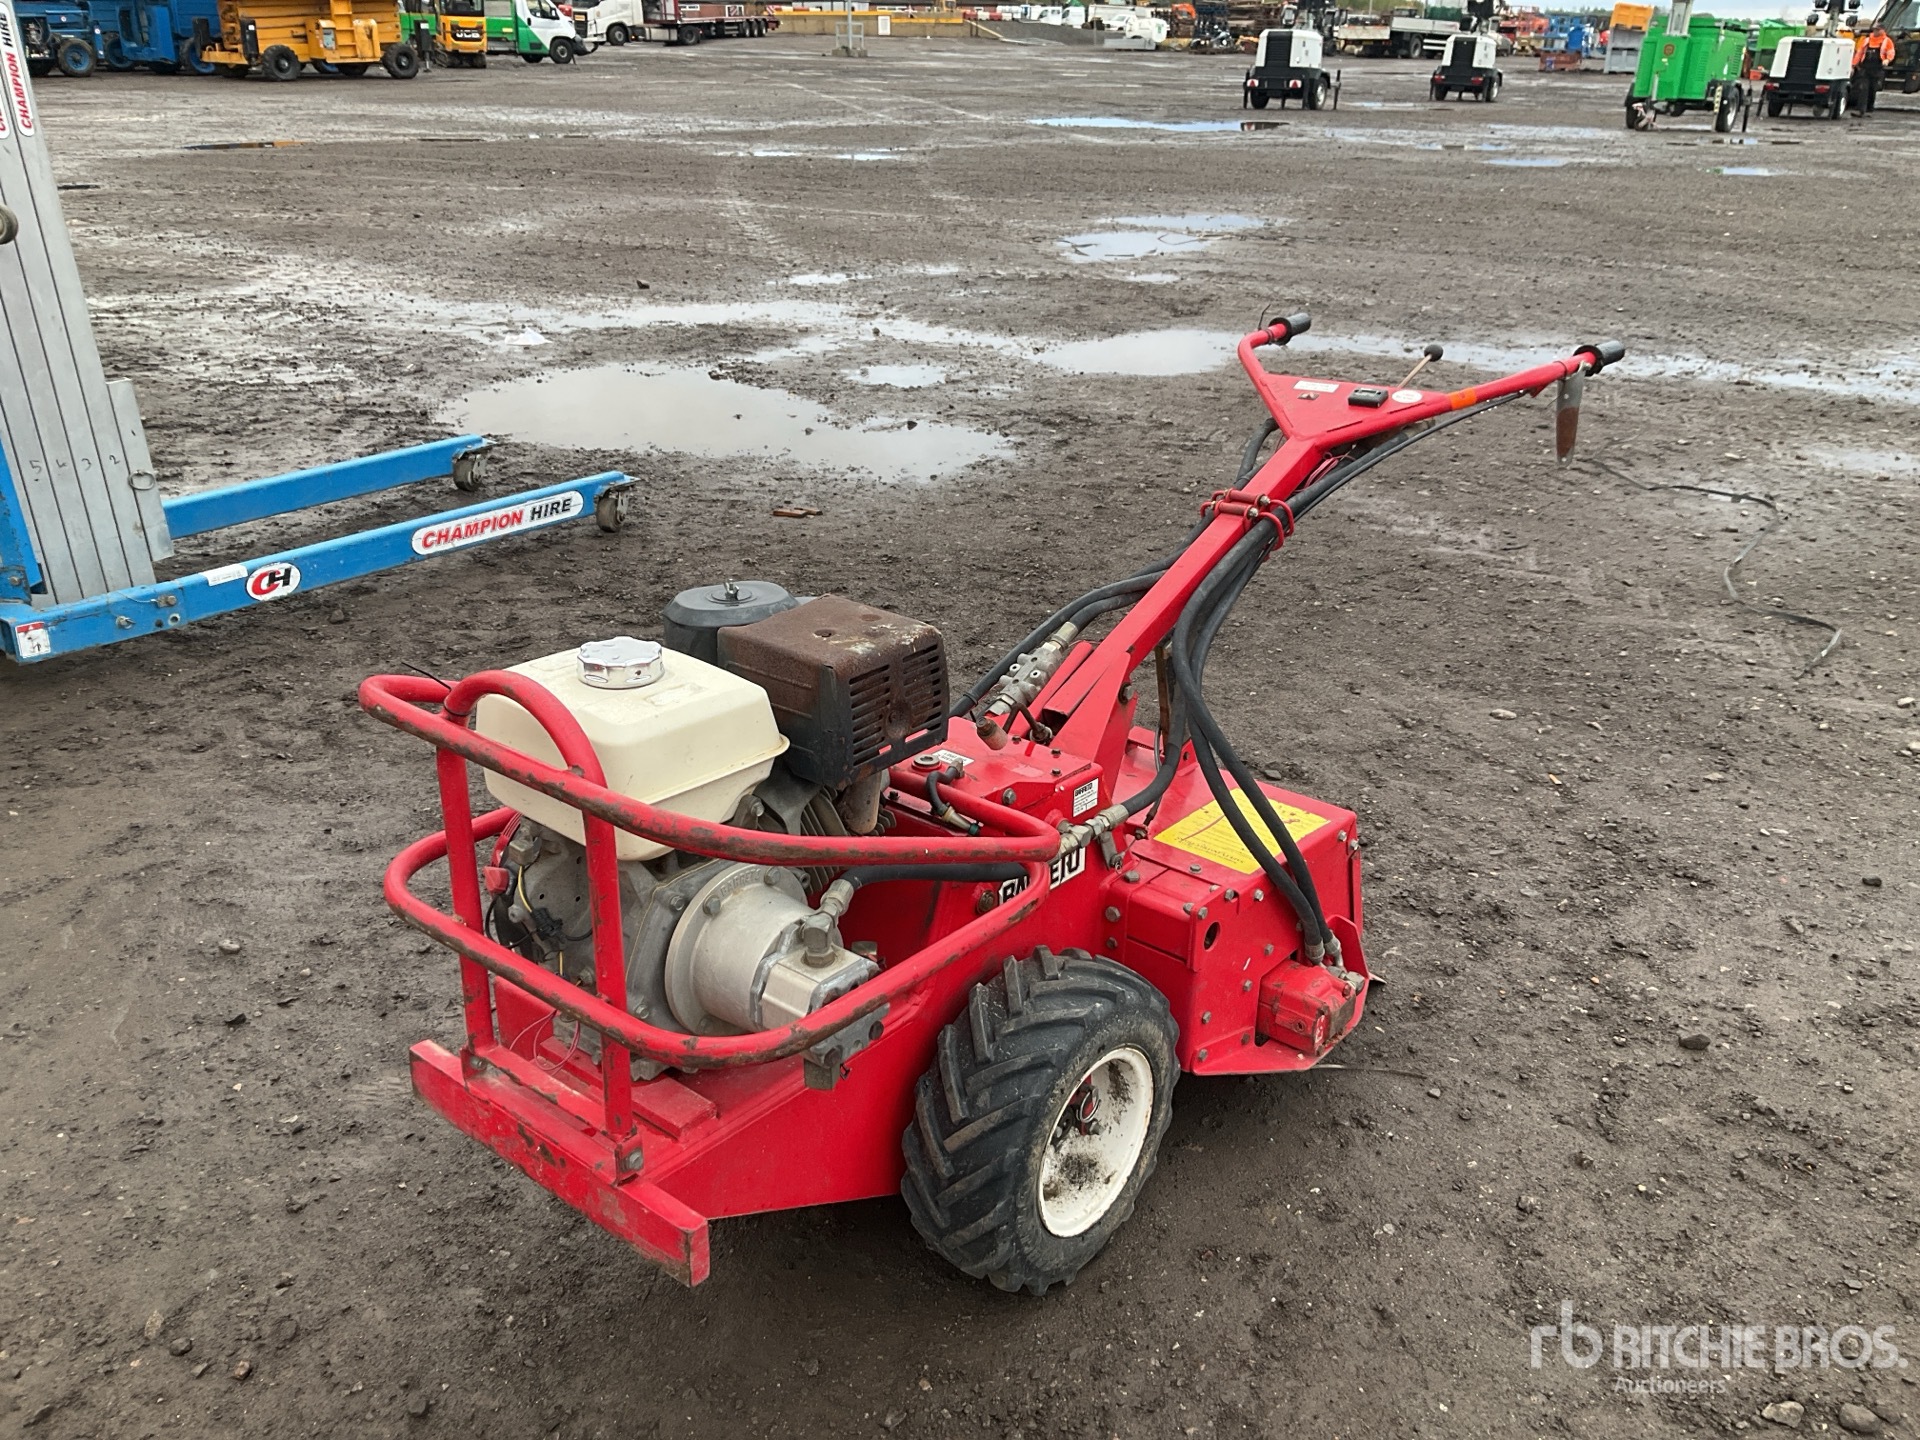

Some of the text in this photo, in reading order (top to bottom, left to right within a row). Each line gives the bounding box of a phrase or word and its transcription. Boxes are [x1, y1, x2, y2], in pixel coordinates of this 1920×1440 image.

[455, 29, 480, 38] JCB
[0, 14, 32, 129] CHAMPION HIRE
[29, 460, 41, 474] 5
[109, 454, 120, 465] 2
[421, 498, 573, 549] CHAMPION HIRE
[251, 567, 292, 596] CH
